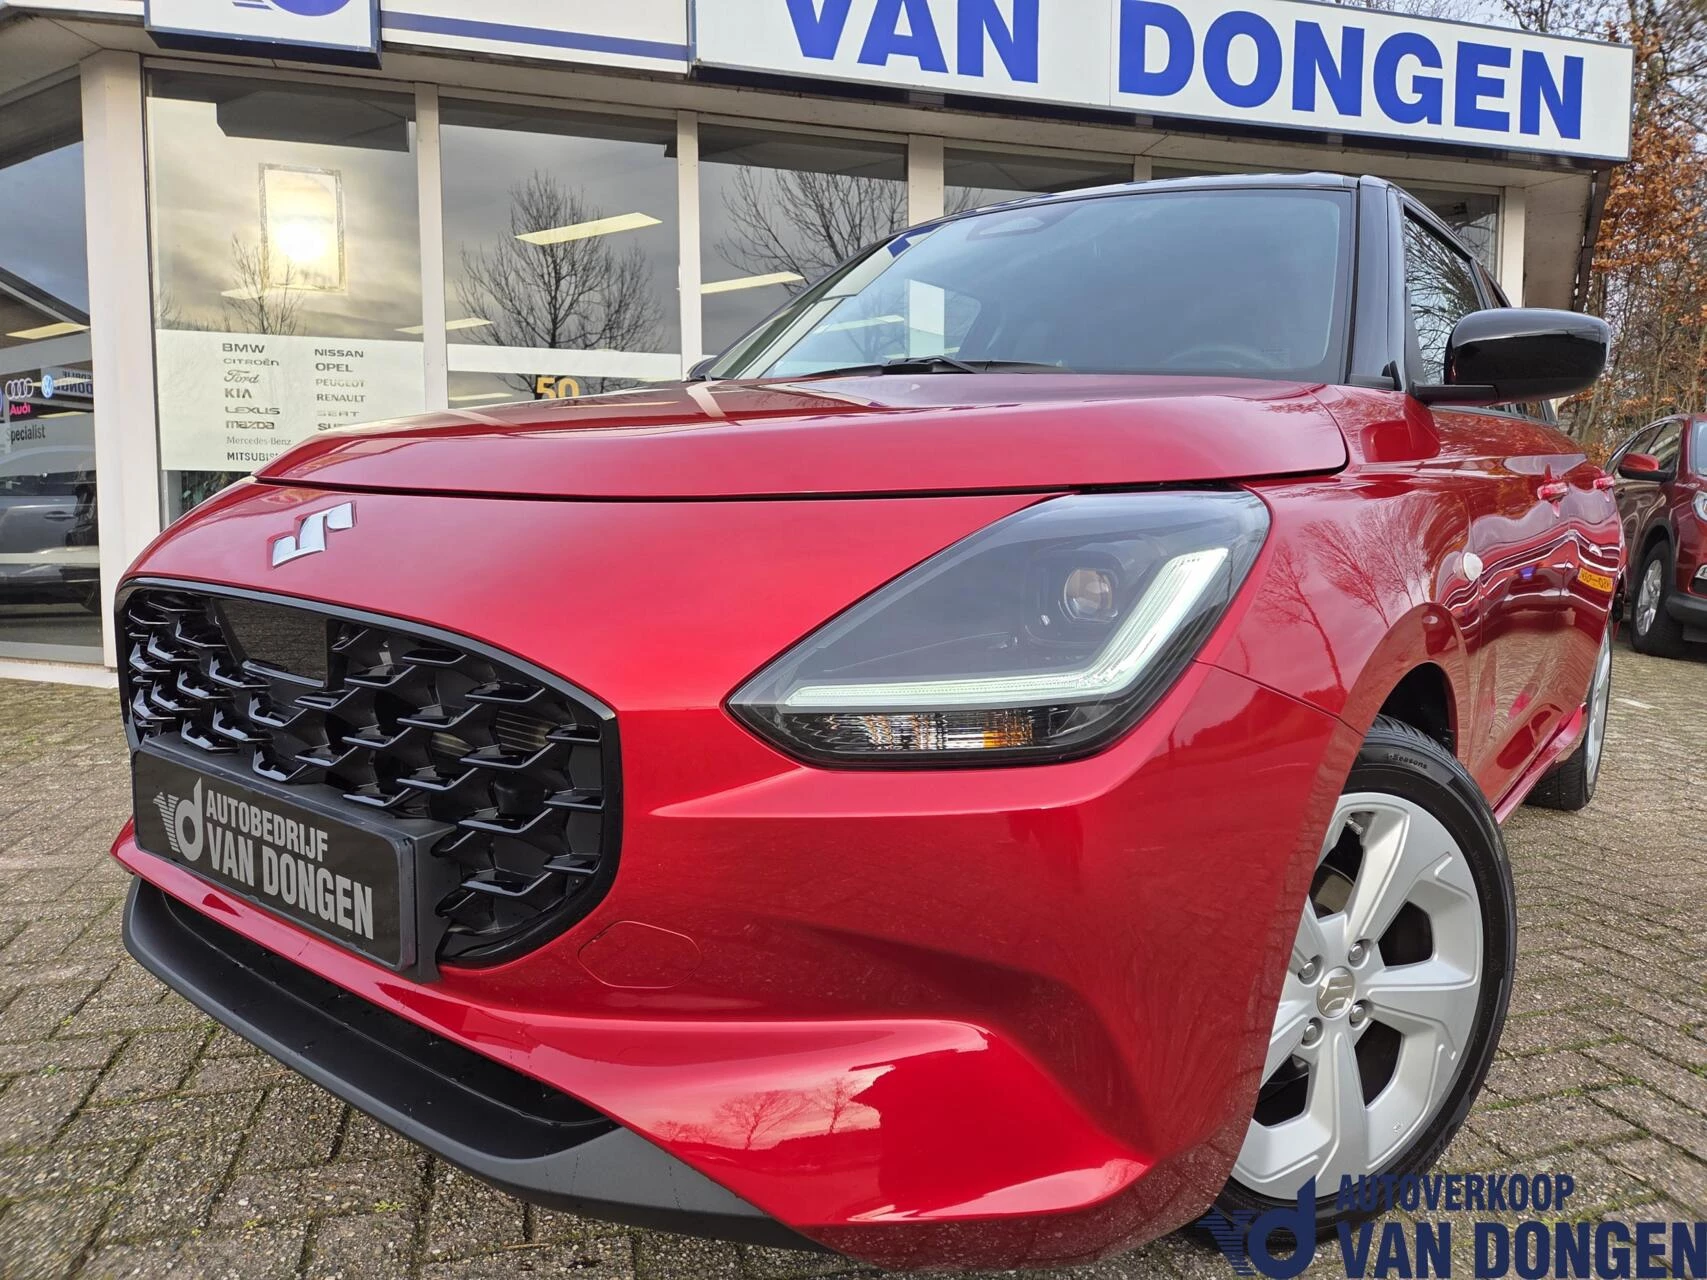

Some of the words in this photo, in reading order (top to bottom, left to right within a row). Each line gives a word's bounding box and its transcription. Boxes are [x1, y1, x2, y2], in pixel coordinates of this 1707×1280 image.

[785, 0, 1039, 84] VAN
[1118, 0, 1584, 140] DONGEN
[222, 343, 265, 353] BMW
[314, 348, 364, 358] NISSAN
[315, 362, 354, 373] OPEL
[223, 369, 260, 384] Ford
[224, 388, 252, 398] KIA
[316, 393, 367, 403] RENAULT
[10, 403, 31, 415] Audi
[225, 406, 281, 415] LEXUS
[206, 789, 328, 862] AUTOBEDRIJF
[207, 823, 255, 887] VAN
[262, 844, 375, 940] DONGEN
